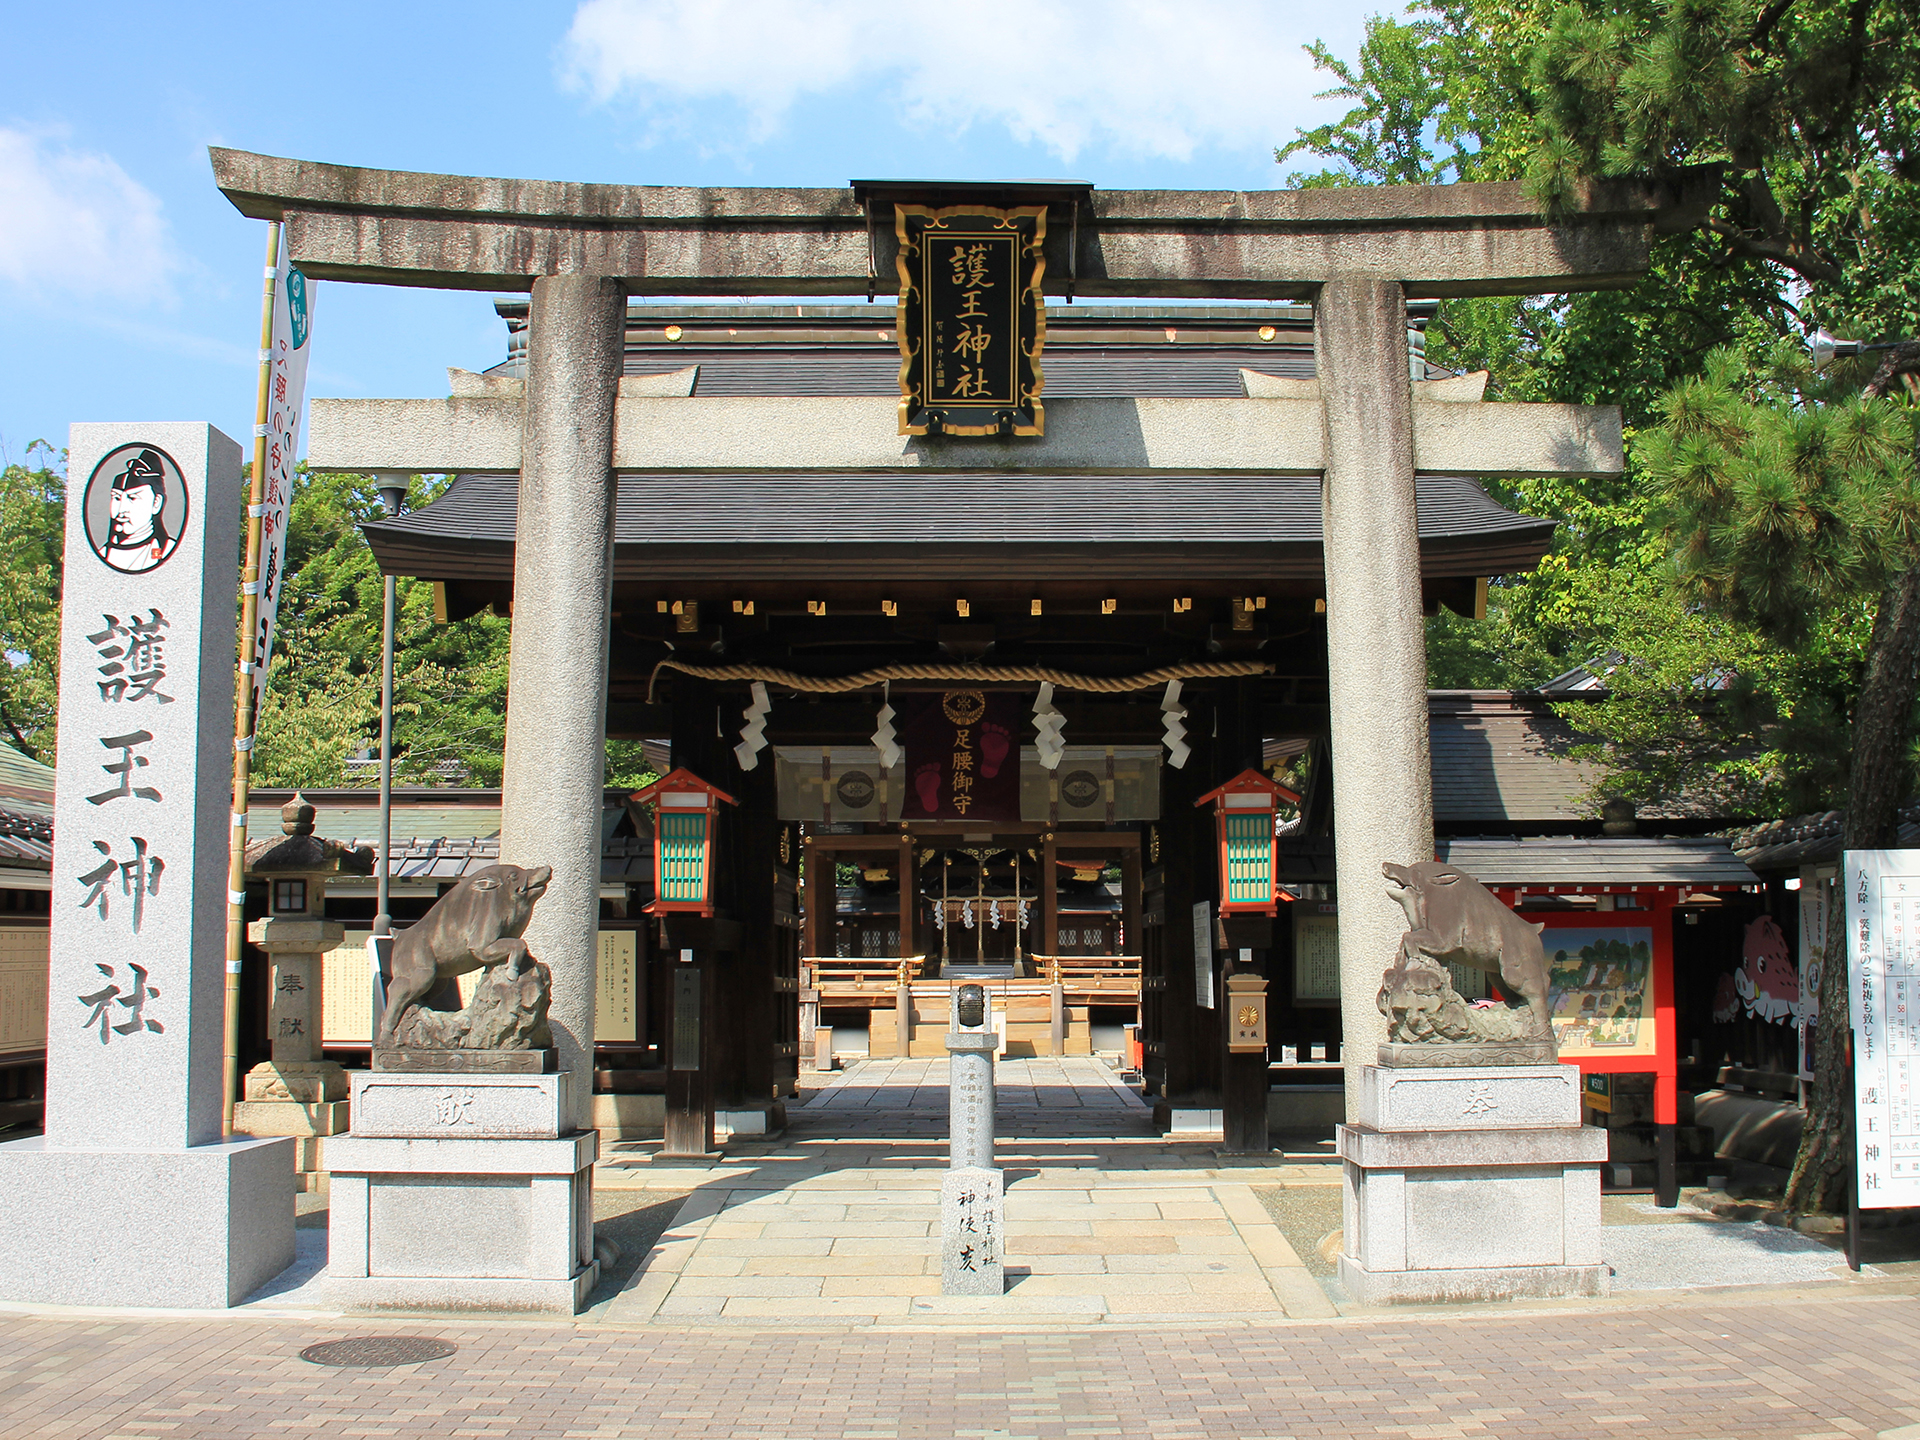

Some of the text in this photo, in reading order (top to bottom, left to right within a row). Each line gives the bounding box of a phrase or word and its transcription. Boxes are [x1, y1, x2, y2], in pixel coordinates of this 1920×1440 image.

[949, 242, 994, 397] 護王神社
[952, 728, 974, 815] 足腰御守
[77, 607, 175, 1046] 護王神社
[1898, 883, 1906, 892] 女
[1463, 1084, 1498, 1118] 奉
[1861, 1087, 1882, 1190] 護王神社
